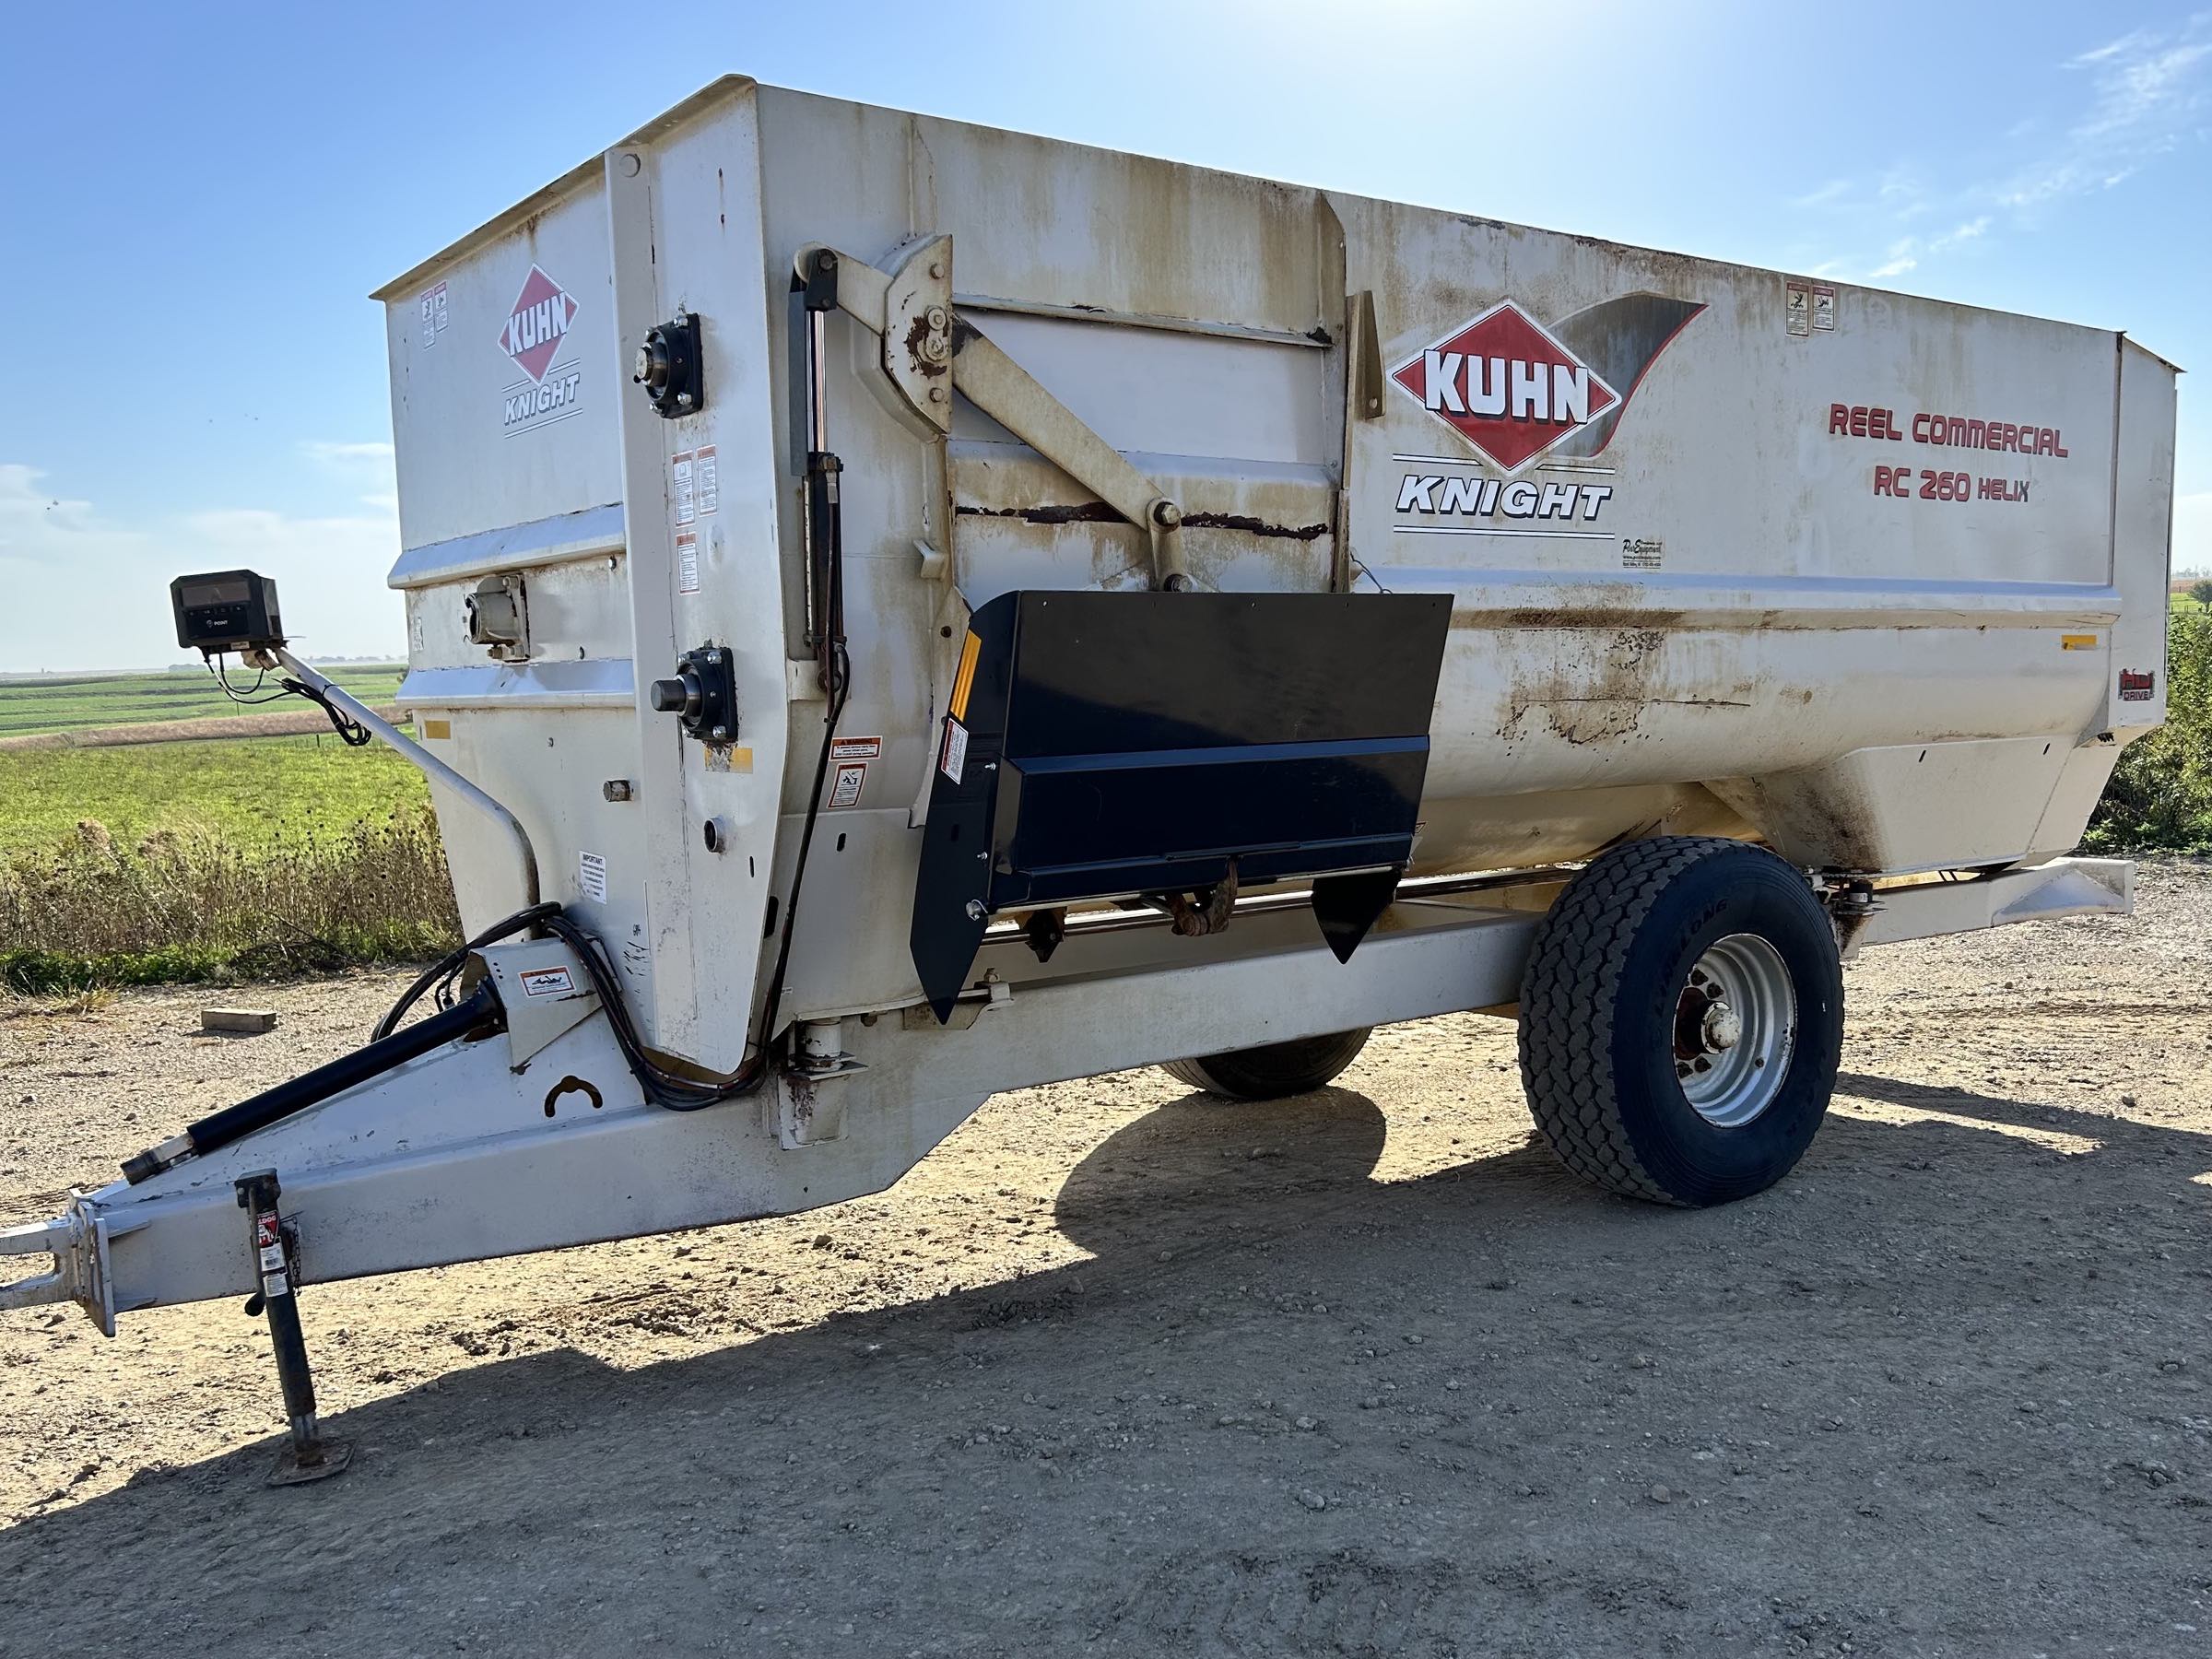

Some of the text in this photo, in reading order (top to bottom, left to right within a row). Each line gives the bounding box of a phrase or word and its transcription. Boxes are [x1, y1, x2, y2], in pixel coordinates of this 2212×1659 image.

[508, 291, 568, 358] KUHN
[503, 372, 581, 427] KNIGHT
[1422, 348, 1589, 425] KUHN
[1829, 403, 2068, 458] REEL COMMERCIAL
[1394, 474, 1613, 522] KNIGHT
[1874, 465, 2030, 503] RC 260 HELIX
[2124, 690, 2149, 700] DRIVE
